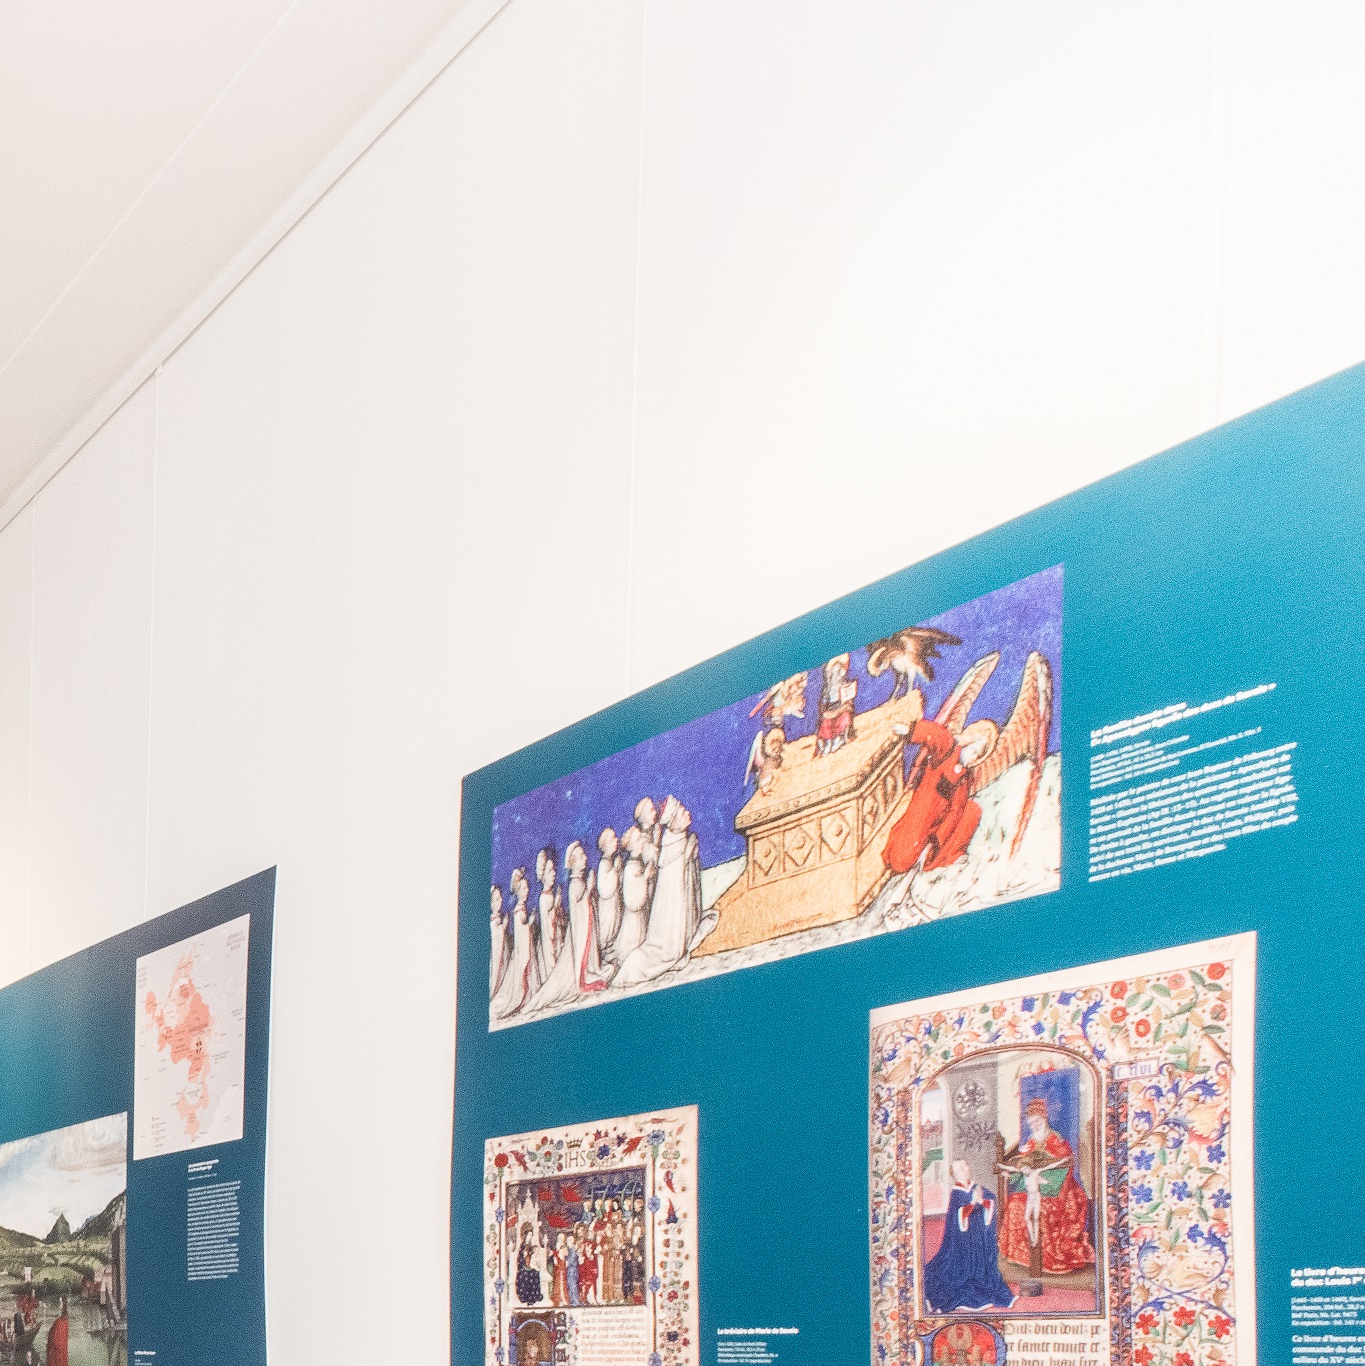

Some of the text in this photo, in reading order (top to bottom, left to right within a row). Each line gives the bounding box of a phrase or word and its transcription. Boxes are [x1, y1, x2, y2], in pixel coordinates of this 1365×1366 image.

[1291, 1268, 1303, 1277] Le
[1304, 1268, 1326, 1277] livre
[1291, 1278, 1305, 1287] du
[1305, 1278, 1324, 1286] duc
[1325, 1277, 1351, 1286] Louis
